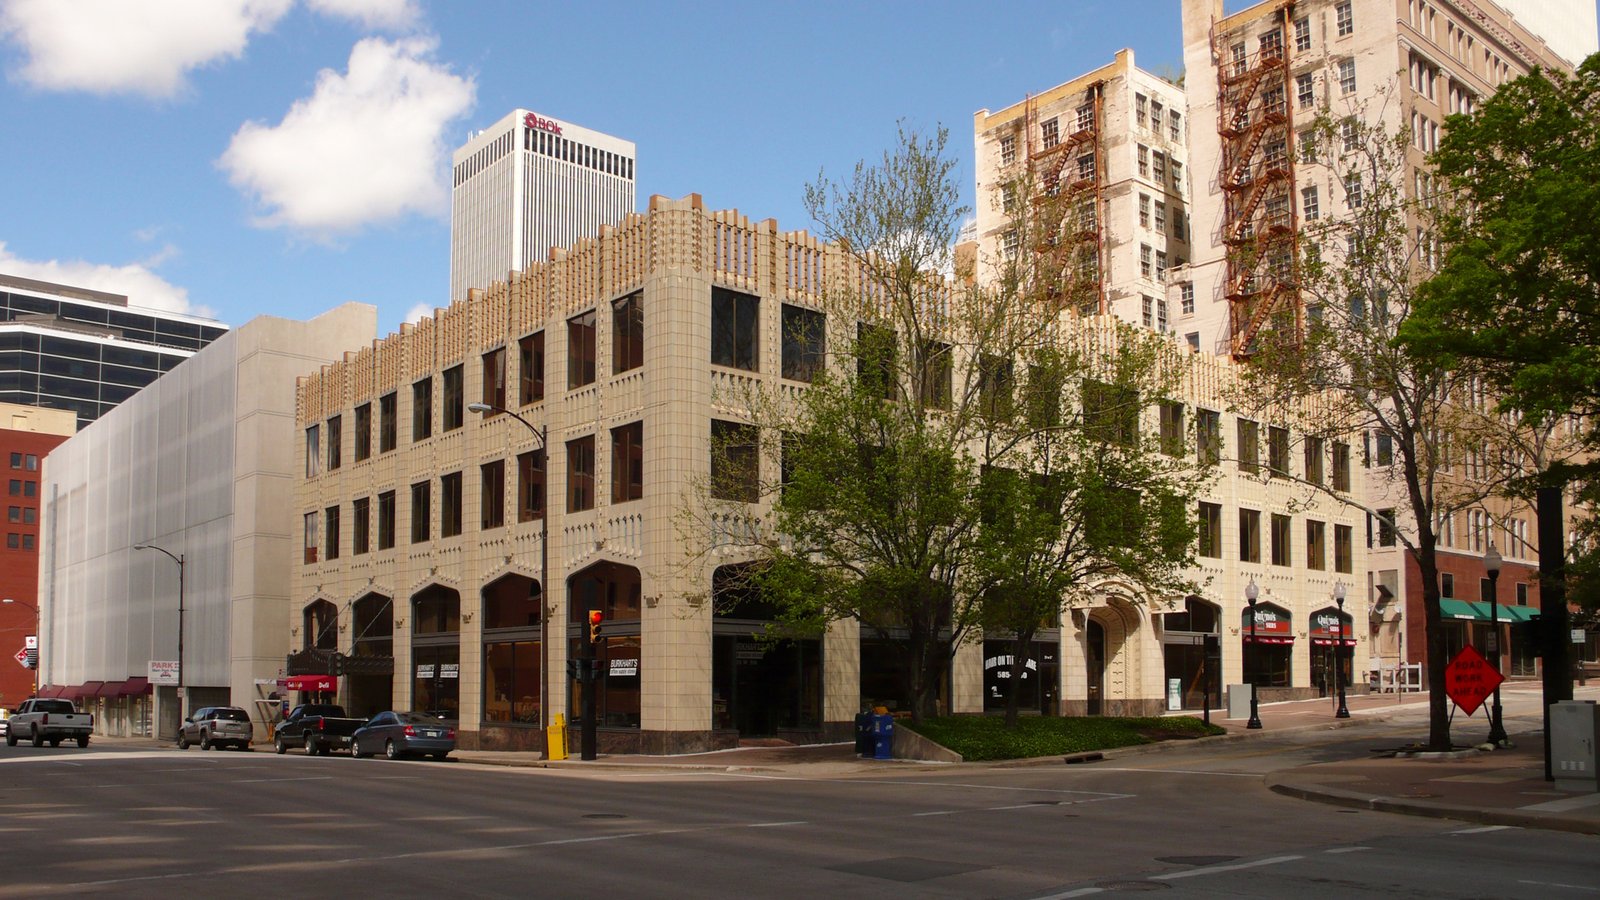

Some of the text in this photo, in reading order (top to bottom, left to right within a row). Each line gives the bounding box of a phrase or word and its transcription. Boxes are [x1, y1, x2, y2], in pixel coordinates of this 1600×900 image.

[151, 661, 174, 669] PARK
[610, 658, 638, 668] BURKHART'S
[997, 655, 1006, 666] ON
[1455, 660, 1482, 670] ROAD
[1455, 674, 1482, 683] WORK
[1453, 686, 1487, 696] AHEAD
